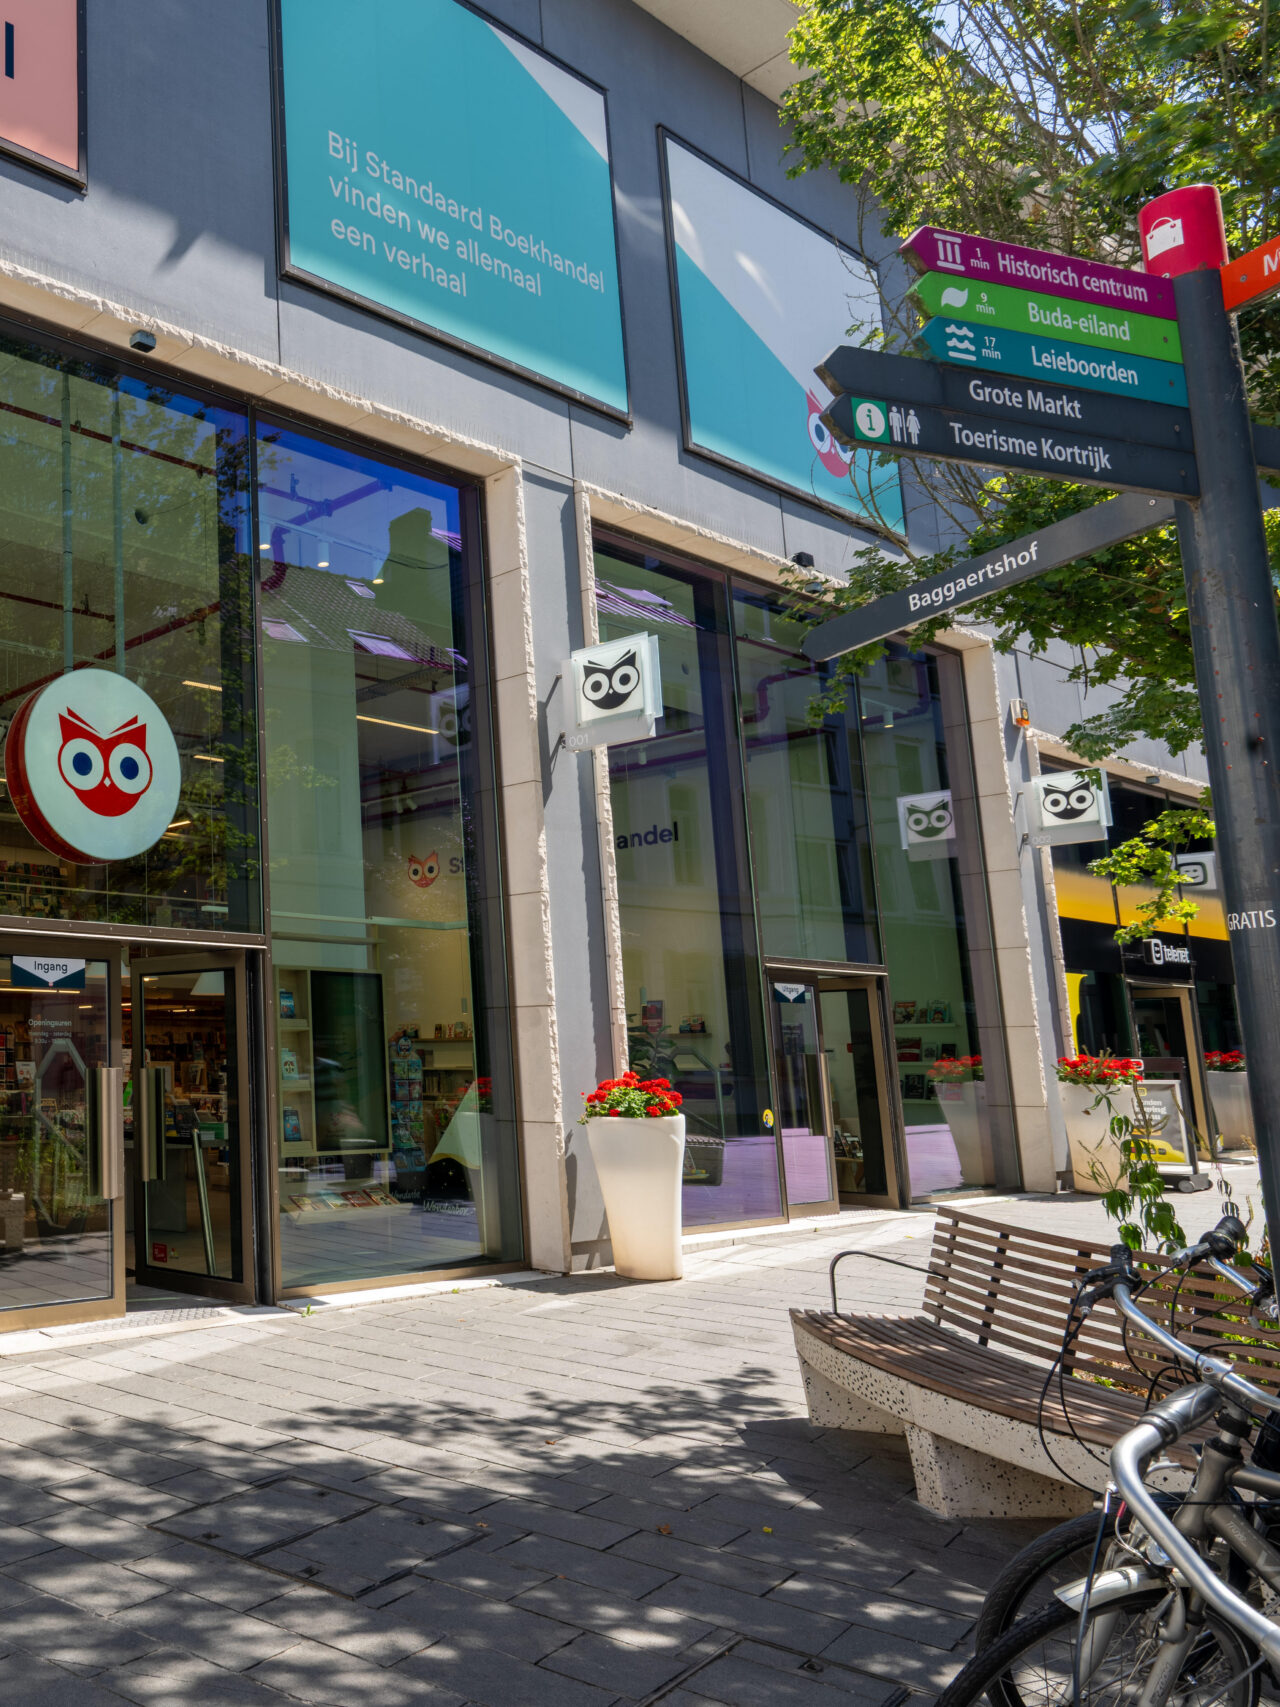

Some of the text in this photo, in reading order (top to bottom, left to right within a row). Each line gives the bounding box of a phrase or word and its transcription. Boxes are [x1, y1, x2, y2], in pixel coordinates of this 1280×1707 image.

[328, 130, 605, 293] Bij Standaard Boekhandel
[328, 175, 541, 297] vinden we allemaal
[331, 218, 467, 297] een verhaal
[970, 248, 990, 270] 1 min
[997, 252, 1148, 302] Historisch centrum
[976, 292, 995, 315] 9 min
[1027, 302, 1131, 341] Buda-eiland
[981, 336, 1001, 360] 17 min
[1031, 345, 1138, 385] Leieboorden
[969, 380, 1082, 419] Grote Markt
[949, 422, 1112, 473] Toerisme Kortrijk
[908, 541, 1038, 612] Baggaertshof
[1227, 909, 1277, 931] GRATIS
[34, 961, 68, 974] Ingang
[1161, 945, 1190, 963] telenet
[28, 1018, 72, 1028] Openingsuren
